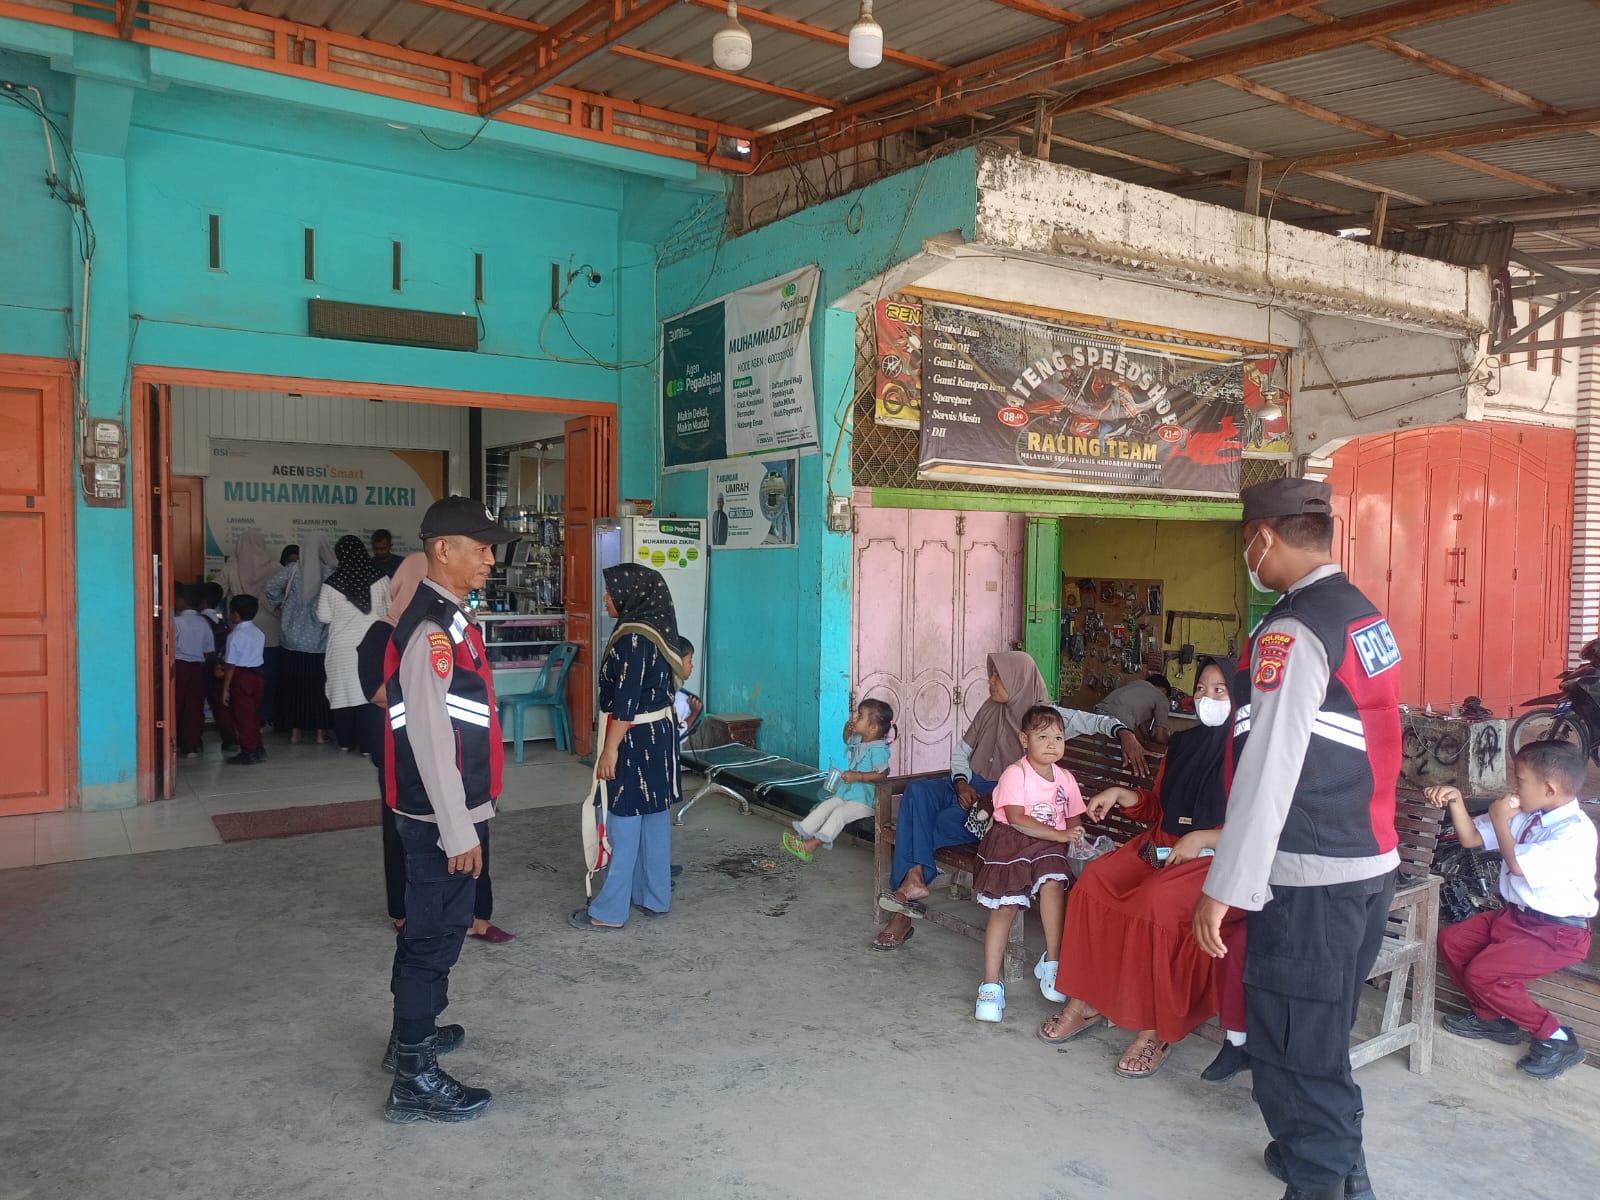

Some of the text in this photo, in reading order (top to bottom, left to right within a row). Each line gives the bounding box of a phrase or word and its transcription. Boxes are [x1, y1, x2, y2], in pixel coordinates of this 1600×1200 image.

[963, 326, 980, 338] Ban
[729, 325, 781, 355] MUHAMMAD
[686, 364, 700, 377] Agen
[933, 356, 973, 371] Ganti Ban
[685, 371, 722, 393] Pegadaian
[933, 374, 957, 386] Ganti
[957, 376, 988, 392] Kampas
[932, 391, 972, 407] Sparepart
[677, 410, 692, 421] Makin
[931, 409, 981, 424] Servis Mesin
[677, 421, 692, 432] Makin
[213, 448, 229, 457] BSI
[1027, 431, 1158, 462] RACING TEAM
[1020, 452, 1052, 461] MELAYANI
[330, 468, 364, 480] Smart
[224, 481, 416, 507] MUHAMMAD ZIKRI
[725, 482, 749, 493] UMRAH
